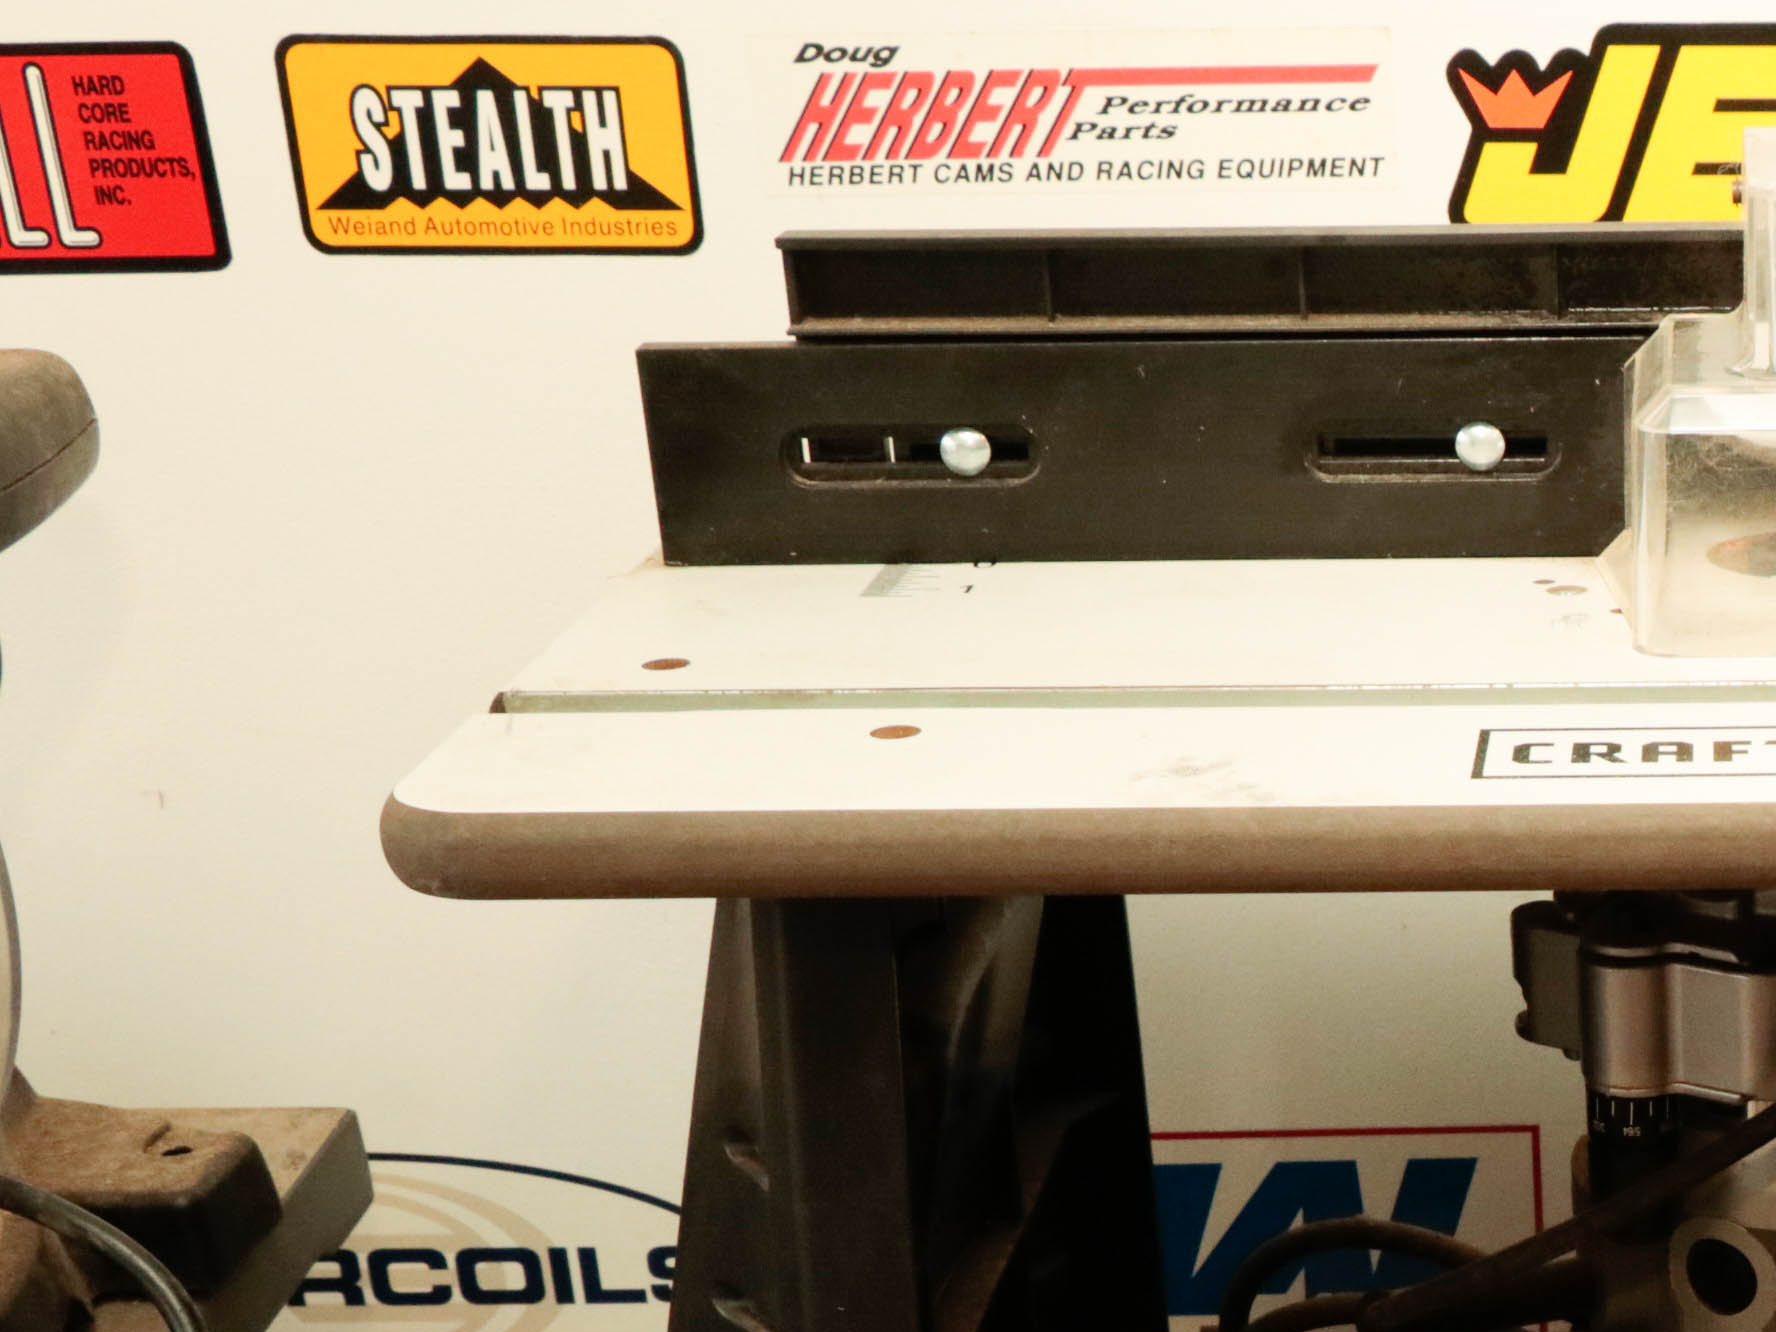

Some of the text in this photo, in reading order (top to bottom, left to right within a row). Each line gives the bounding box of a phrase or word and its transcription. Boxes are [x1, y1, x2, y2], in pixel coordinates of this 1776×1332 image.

[793, 42, 900, 68] Doug
[72, 75, 125, 96] HARD
[78, 103, 131, 123] CORE
[1096, 93, 1372, 116] Performance
[83, 130, 155, 150] RACING
[349, 83, 628, 193] STEALTH
[1066, 120, 1178, 141] Parts
[89, 157, 196, 180] PRODUCTS,
[788, 157, 1386, 187] HERBERT CAMS AND RACING EQUIPMENT
[95, 185, 132, 205] INC.
[329, 216, 678, 237] Weiand Automotive Industries
